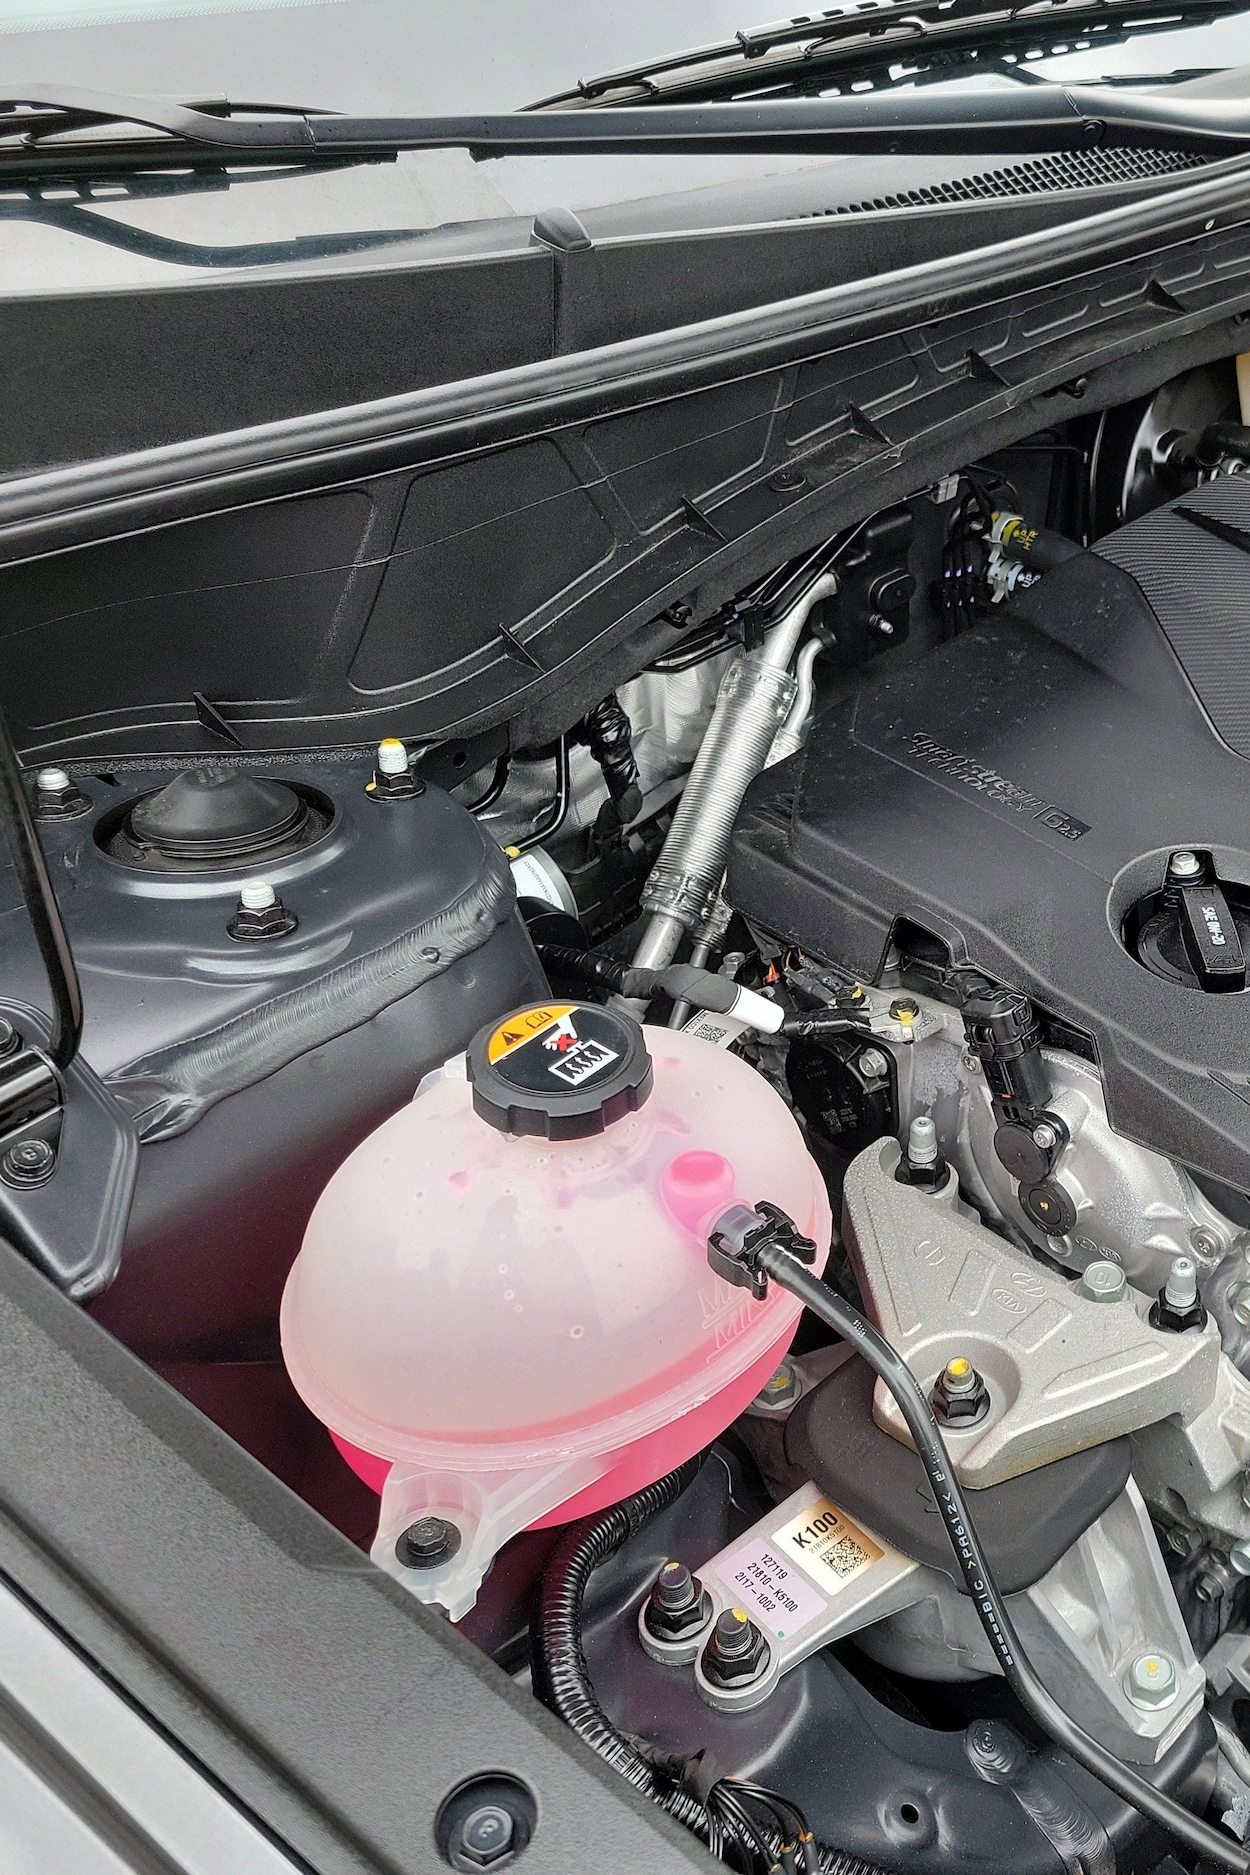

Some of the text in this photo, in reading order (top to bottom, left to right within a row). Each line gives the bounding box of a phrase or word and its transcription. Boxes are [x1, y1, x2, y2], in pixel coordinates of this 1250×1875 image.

[1201, 906, 1226, 946] SAE 0W-20
[792, 1511, 839, 1549] K100
[808, 1524, 846, 1554] 21810K5100
[760, 1553, 789, 1580] 127119
